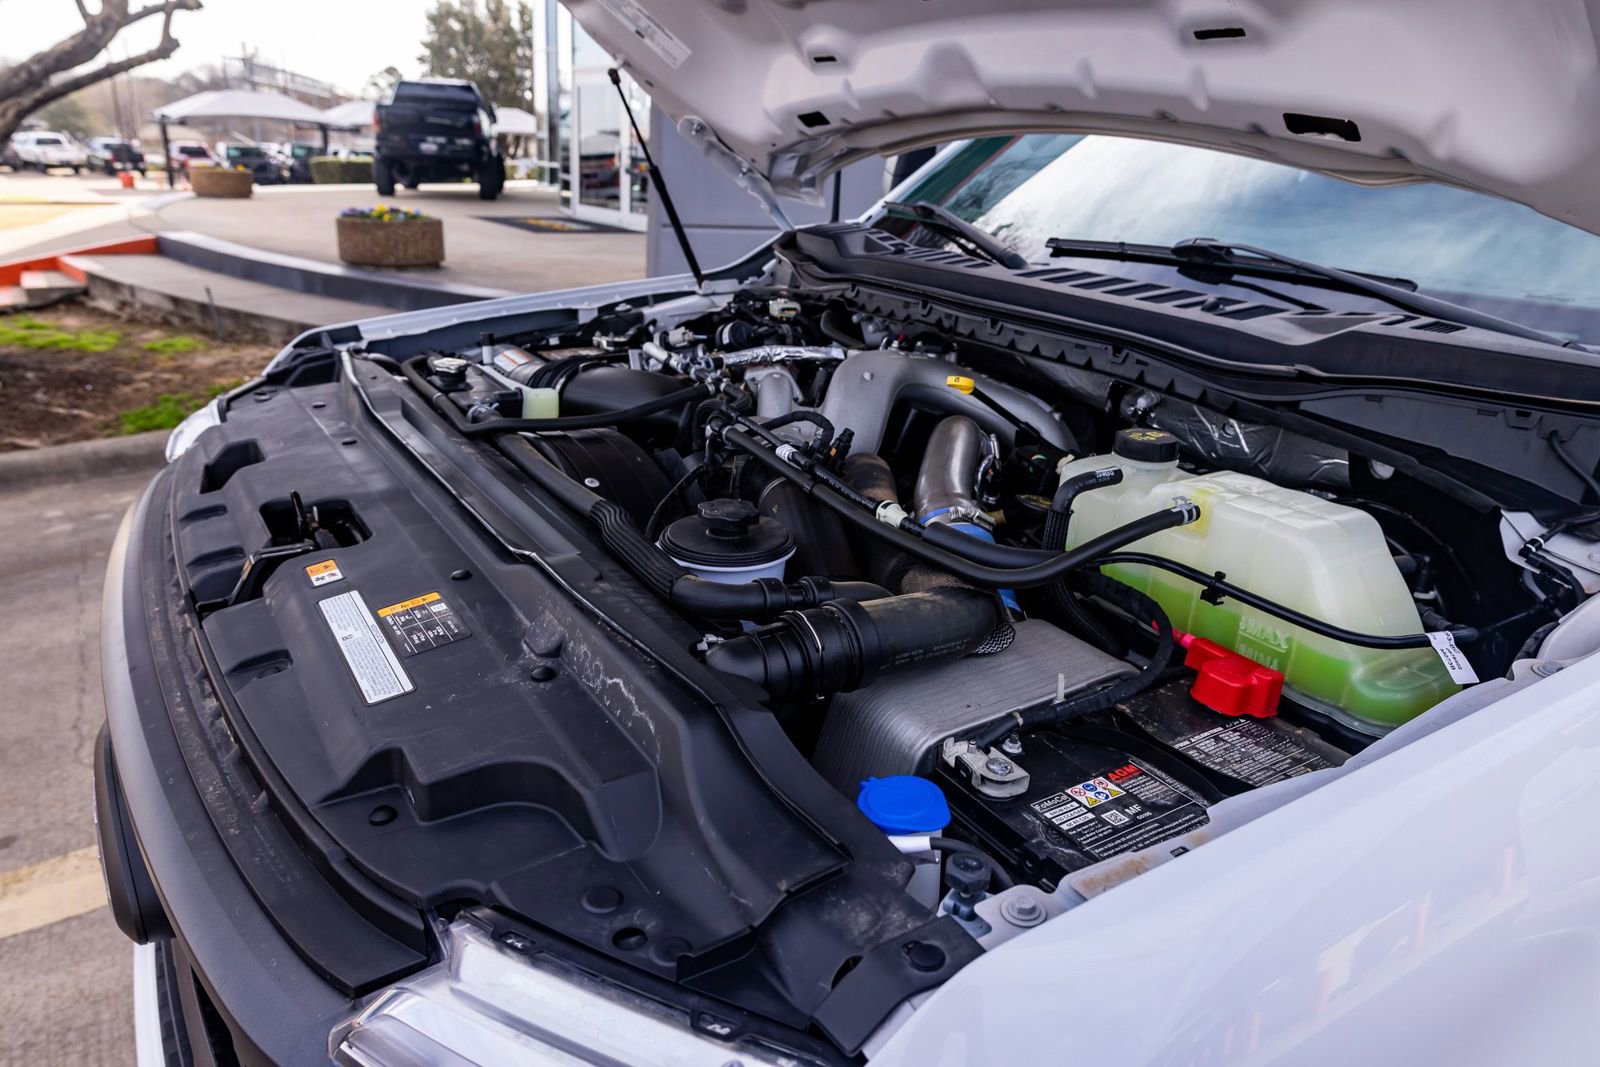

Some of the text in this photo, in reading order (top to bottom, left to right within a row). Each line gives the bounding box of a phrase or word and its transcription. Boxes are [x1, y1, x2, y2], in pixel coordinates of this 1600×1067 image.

[1107, 764, 1139, 781] AGM
[1035, 795, 1069, 811] FoMoCo
[1124, 804, 1141, 815] MF
